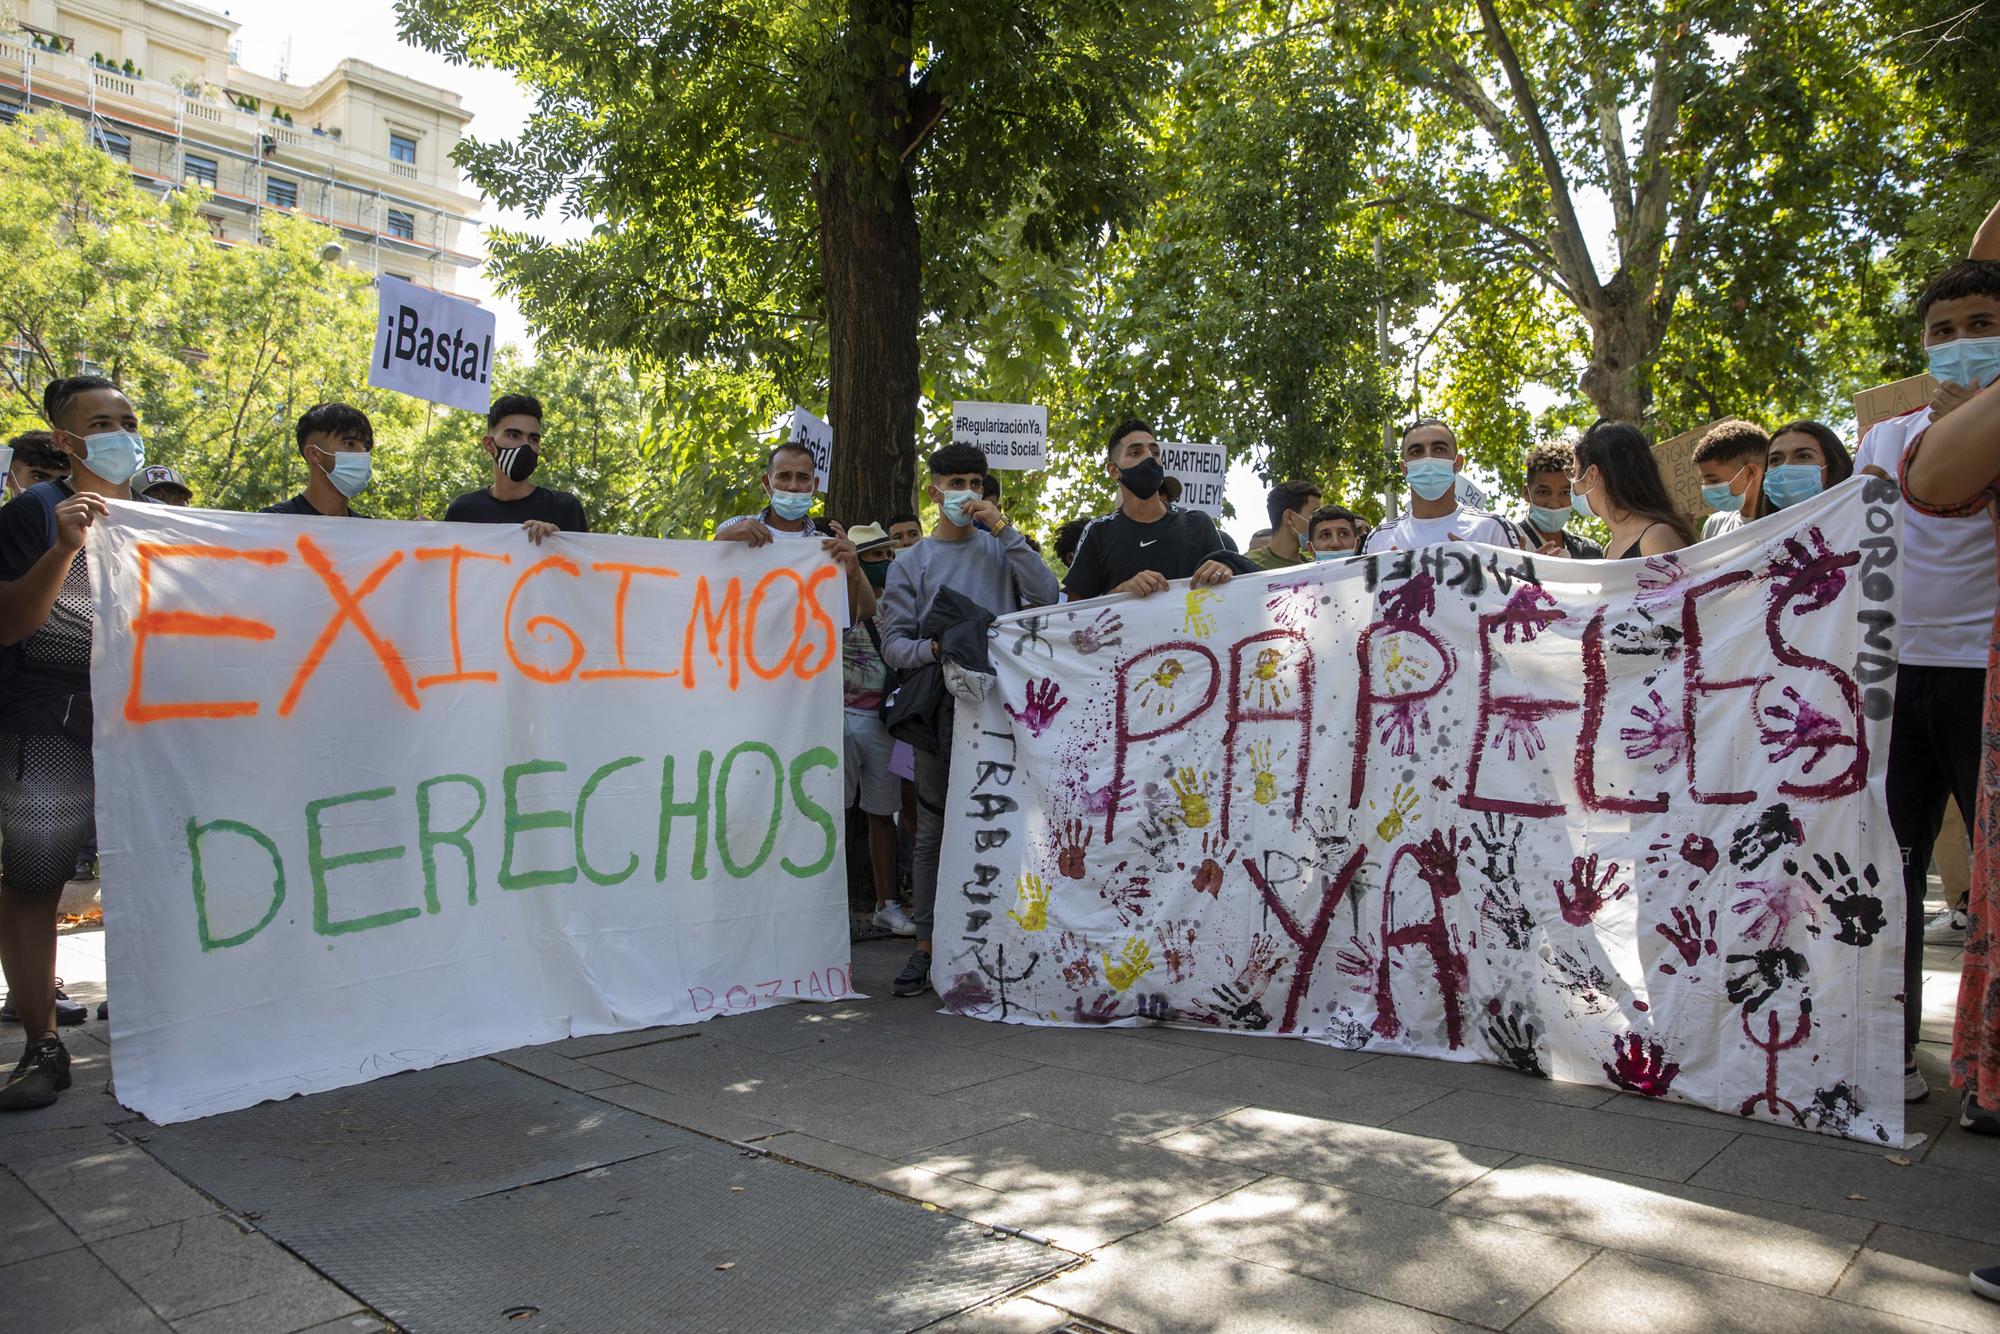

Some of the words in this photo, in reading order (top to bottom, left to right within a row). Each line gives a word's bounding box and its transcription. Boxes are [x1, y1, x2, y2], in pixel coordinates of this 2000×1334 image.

[383, 304, 491, 384] ¡Basta!
[1011, 440, 1041, 456] Social.
[1184, 483, 1197, 504] TU
[1199, 484, 1221, 505] LEY!
[124, 535, 838, 722] EXIGIMOS
[1105, 550, 1868, 842] PAPELES
[188, 741, 839, 952] DERECHOS
[953, 727, 1019, 960] TRABAJAR
[1241, 842, 1465, 1050] YA
